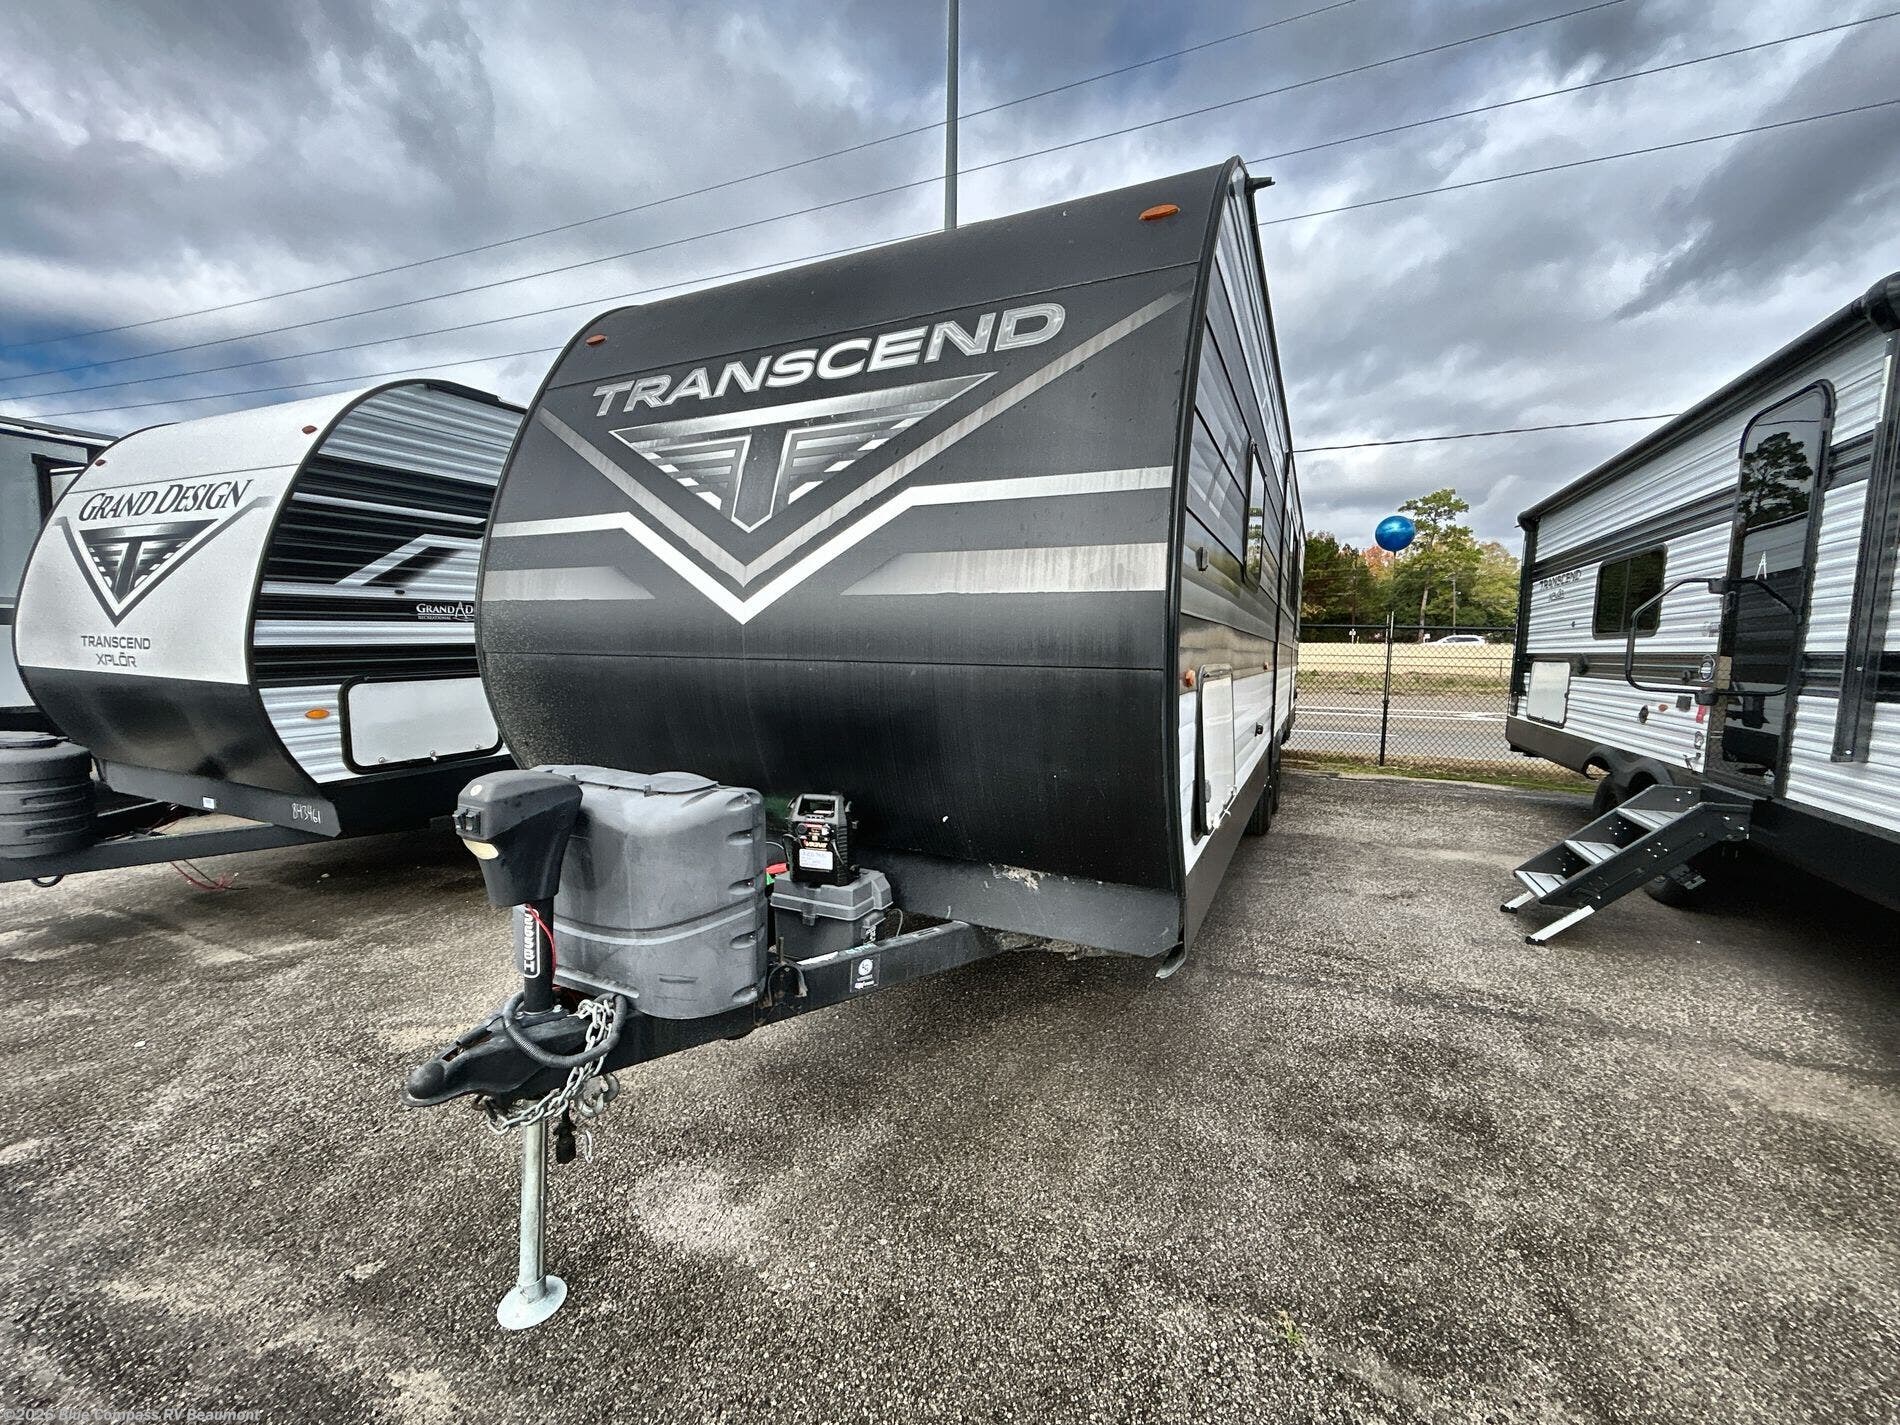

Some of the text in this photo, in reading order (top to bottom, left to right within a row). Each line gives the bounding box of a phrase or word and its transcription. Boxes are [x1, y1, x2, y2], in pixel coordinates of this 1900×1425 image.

[592, 302, 1066, 417] TRANSCEND
[78, 479, 254, 521] GRAND DESIGN
[80, 635, 151, 650] TRANSCEND
